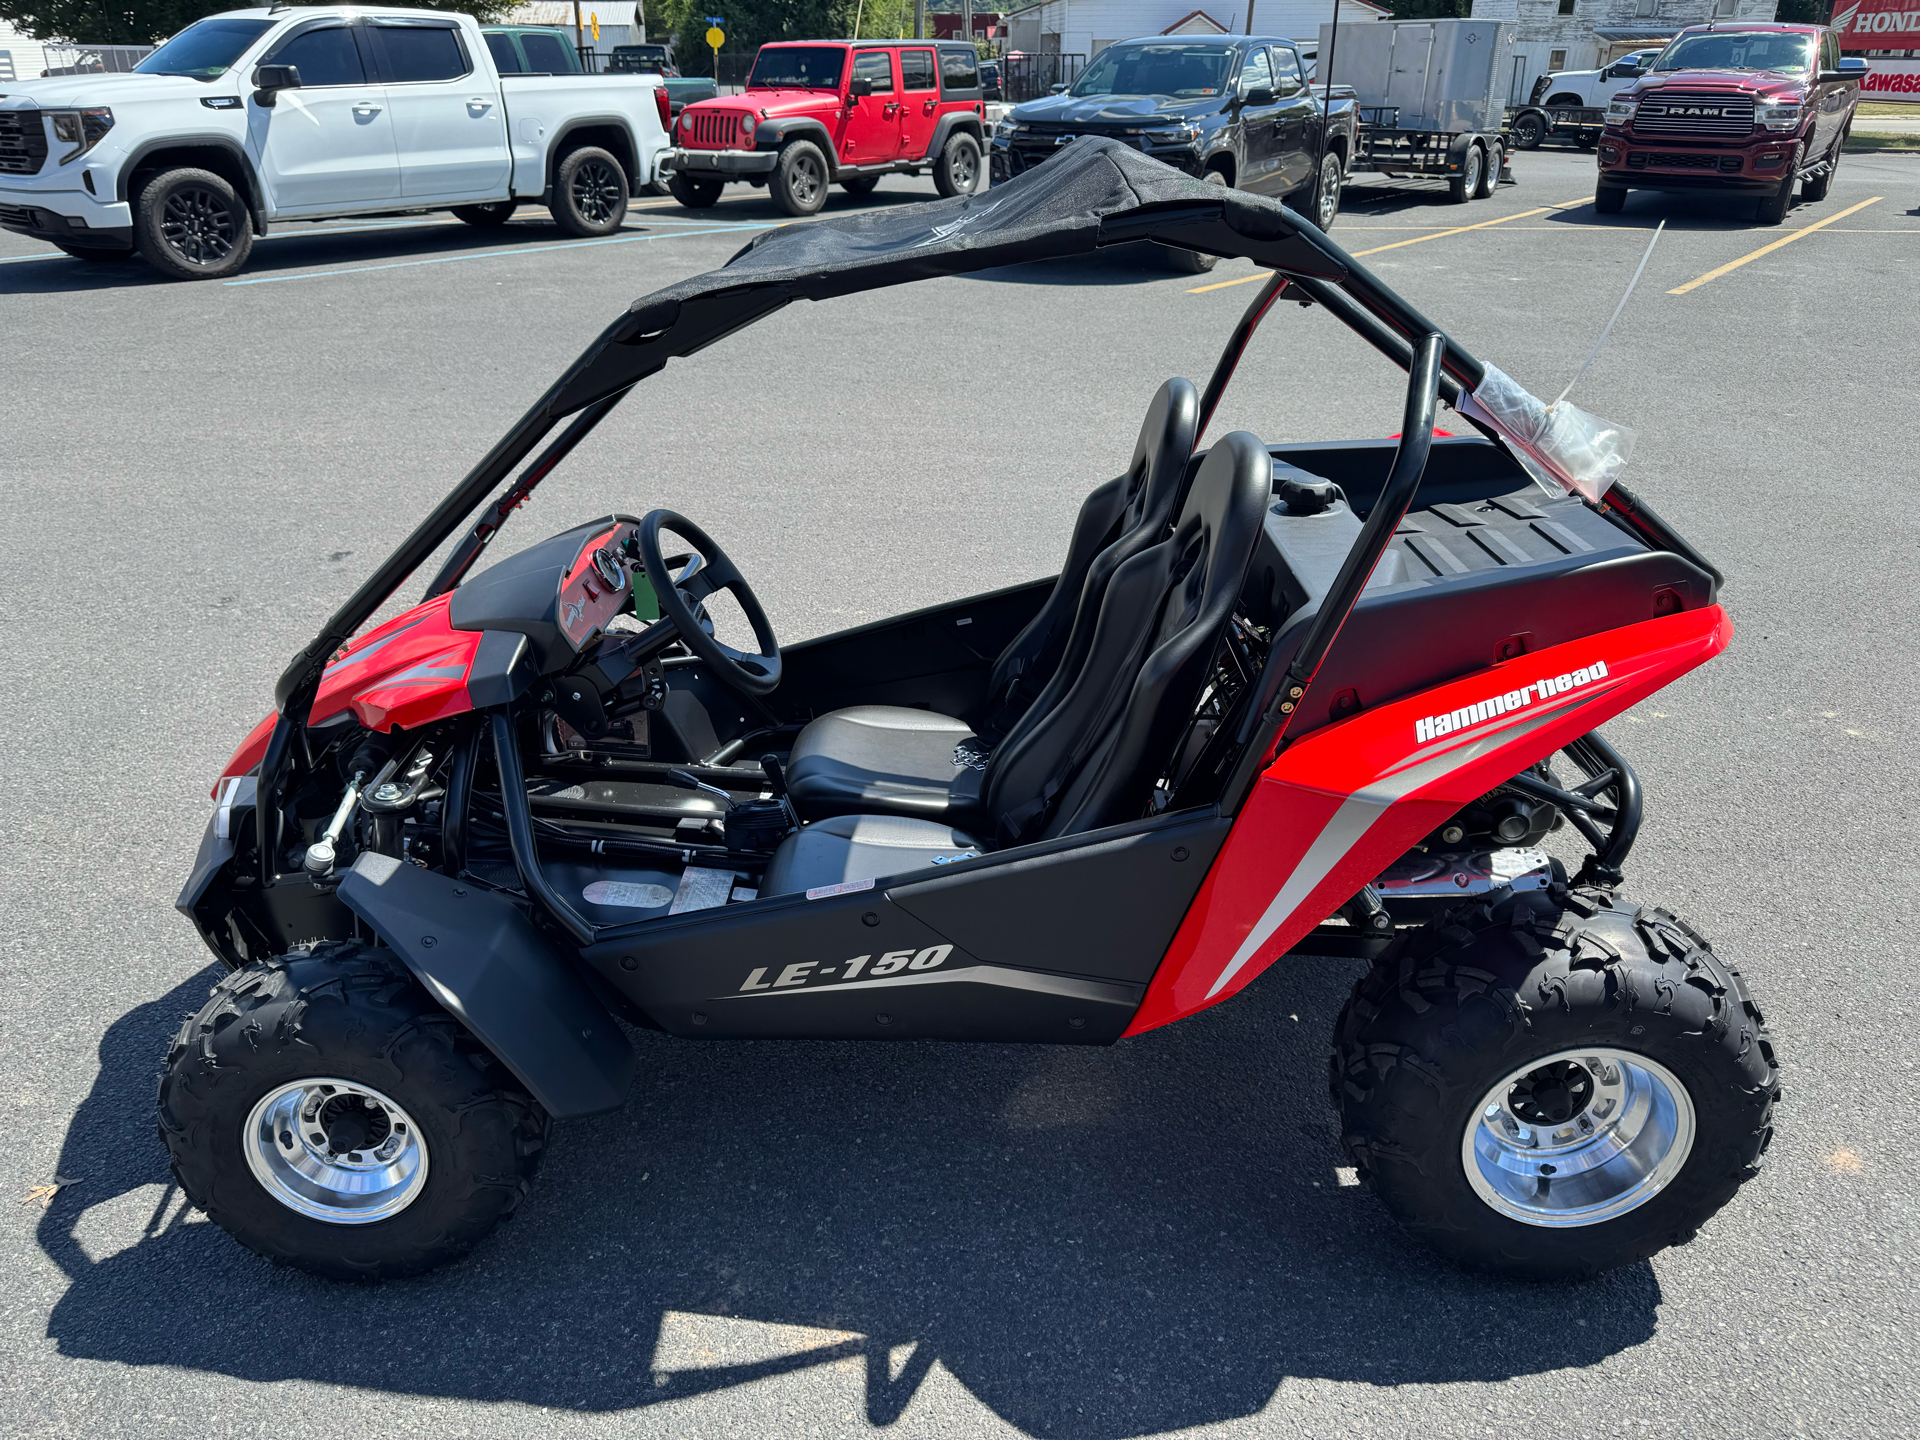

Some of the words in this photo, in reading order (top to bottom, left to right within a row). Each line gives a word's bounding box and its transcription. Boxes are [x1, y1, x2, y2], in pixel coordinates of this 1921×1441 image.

[1669, 107, 1720, 115] RAM
[1414, 660, 1609, 744] Hammerhead
[739, 944, 954, 992] LE-150
